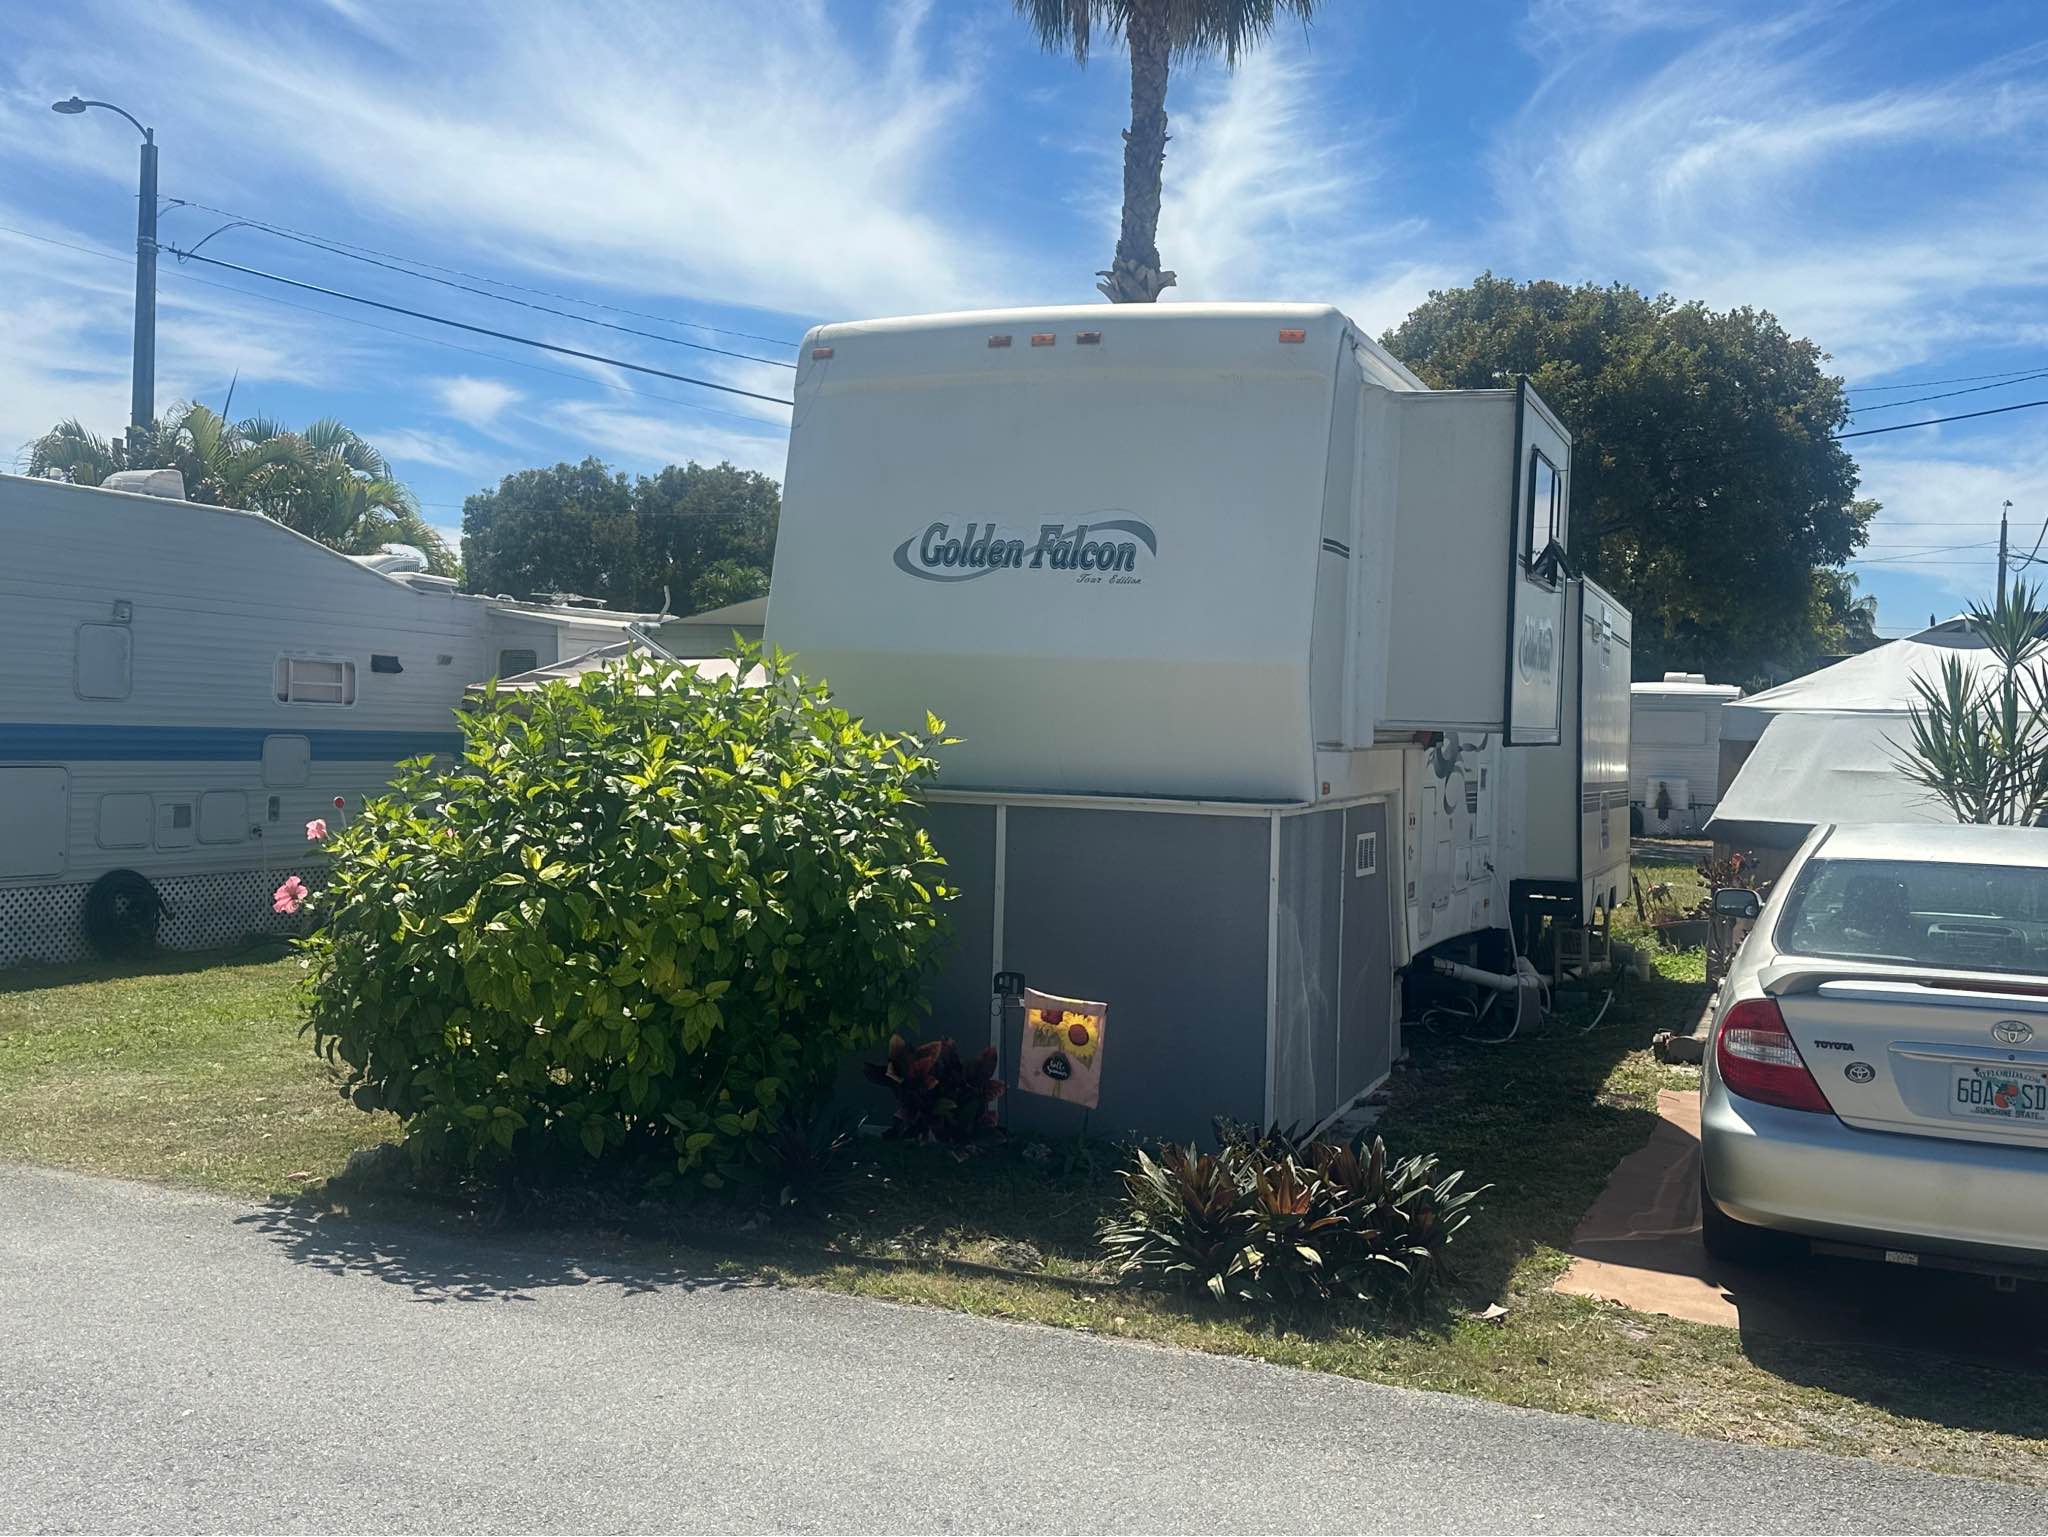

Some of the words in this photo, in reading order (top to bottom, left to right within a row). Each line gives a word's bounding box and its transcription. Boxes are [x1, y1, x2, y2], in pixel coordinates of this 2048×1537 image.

[919, 522, 1024, 568] Golden
[1029, 524, 1137, 572] Falcon
[1076, 573, 1102, 584] Tour
[1108, 574, 1143, 585] Edition
[1814, 1040, 1855, 1051] TOYOTA
[1975, 1106, 2012, 1118] SUNSHINE
[2015, 1110, 2041, 1120] STATE
